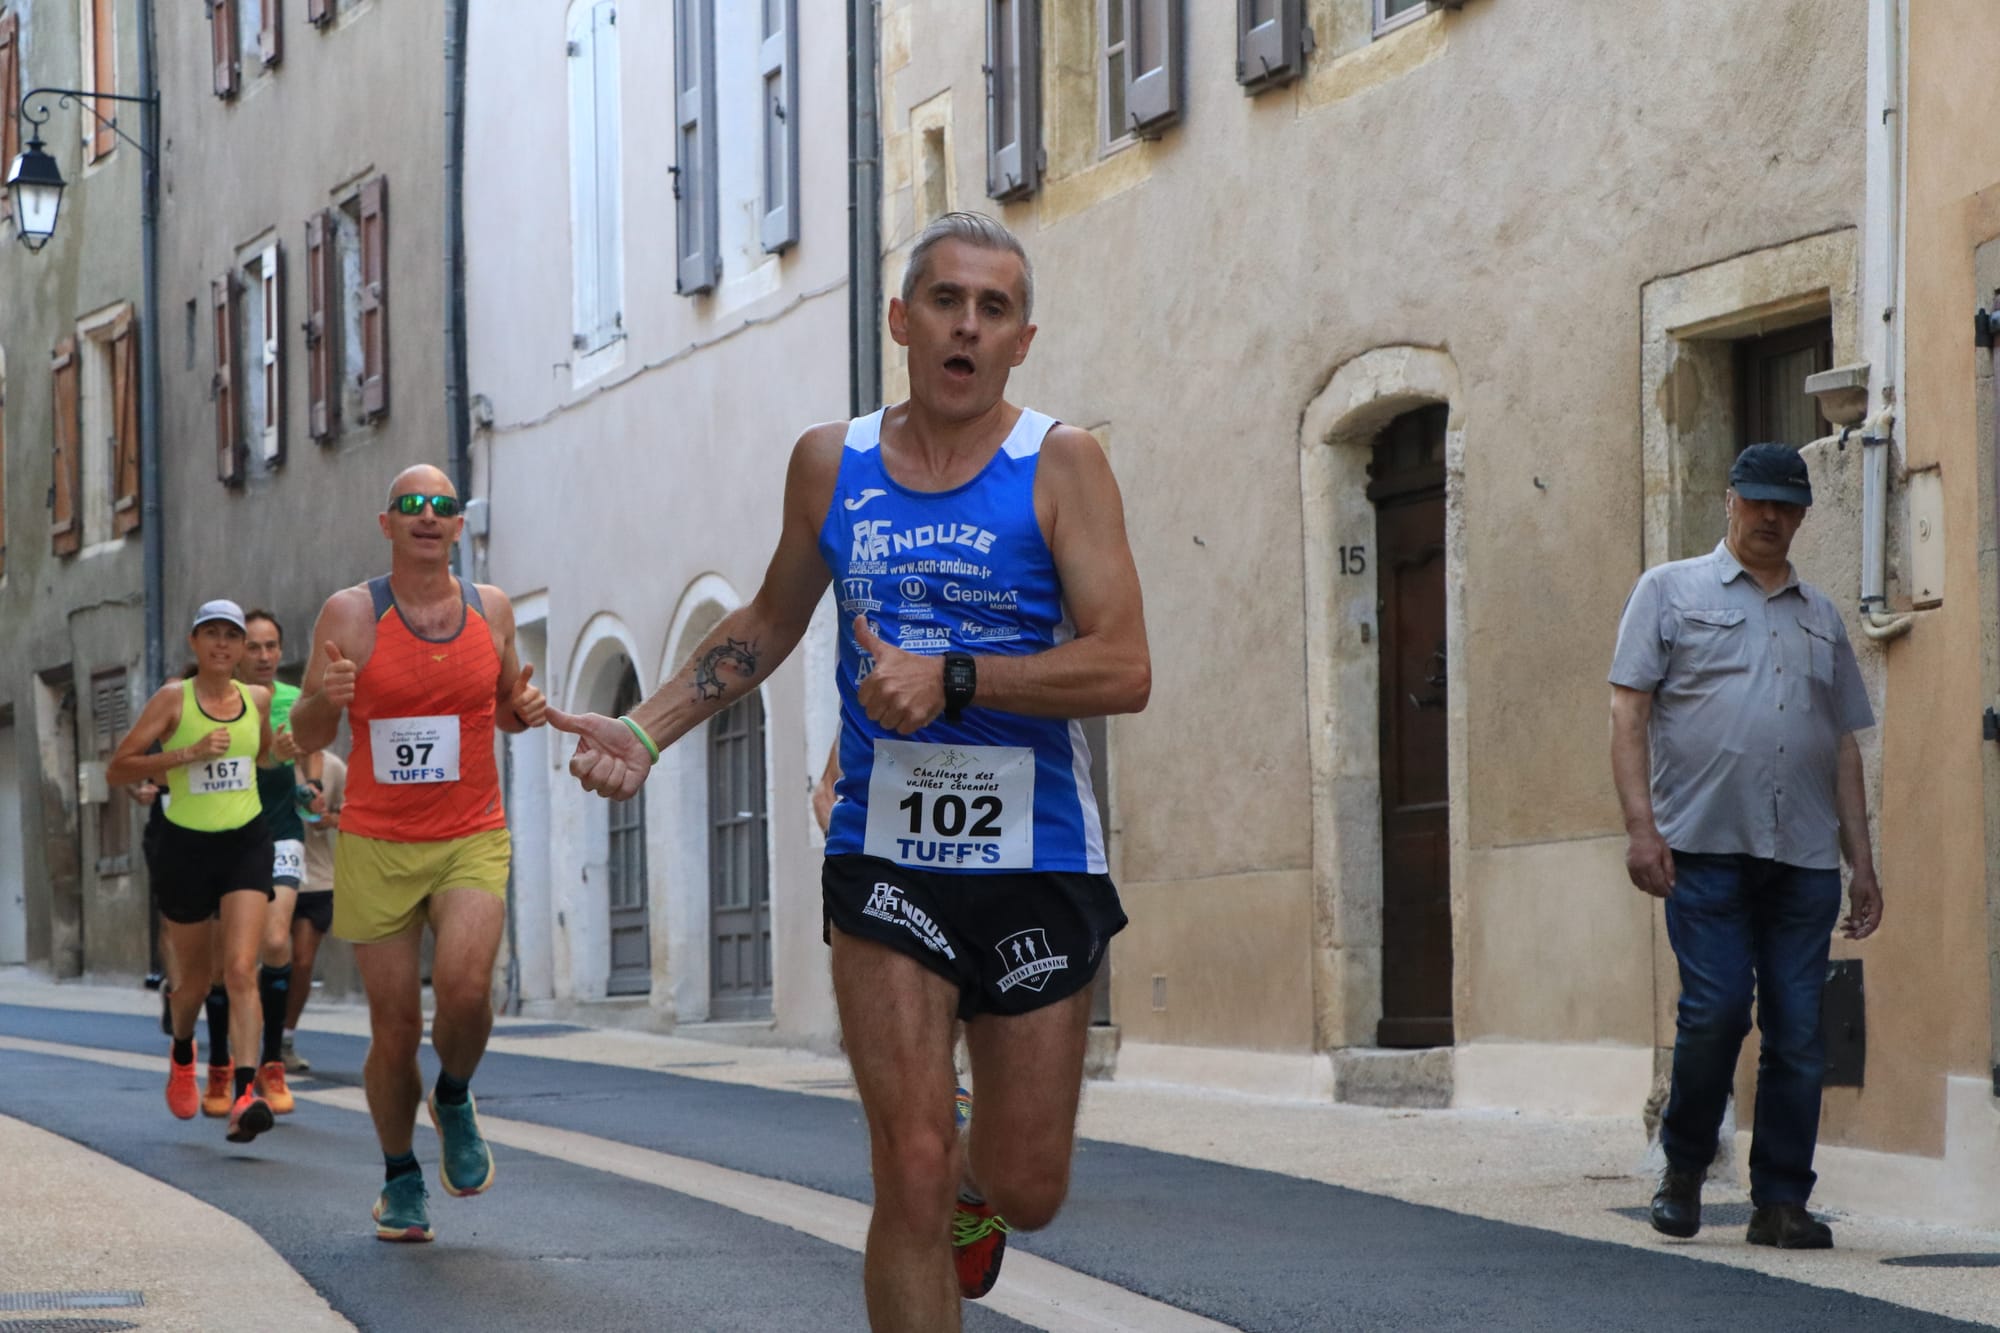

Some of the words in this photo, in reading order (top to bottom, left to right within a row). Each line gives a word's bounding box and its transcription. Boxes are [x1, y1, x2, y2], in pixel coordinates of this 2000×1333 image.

[890, 558, 992, 579] www.acn-anduze.fr
[1338, 546, 1366, 576] 15
[926, 627, 952, 638] BAT
[396, 743, 434, 767] 97
[204, 761, 239, 780] 167
[389, 768, 445, 781] TUFF'S
[912, 767, 968, 783] Challenge
[975, 771, 994, 781] des
[900, 791, 1003, 837] 102
[897, 838, 1001, 864] TUFF'S
[1032, 957, 1066, 973] RUNNING
